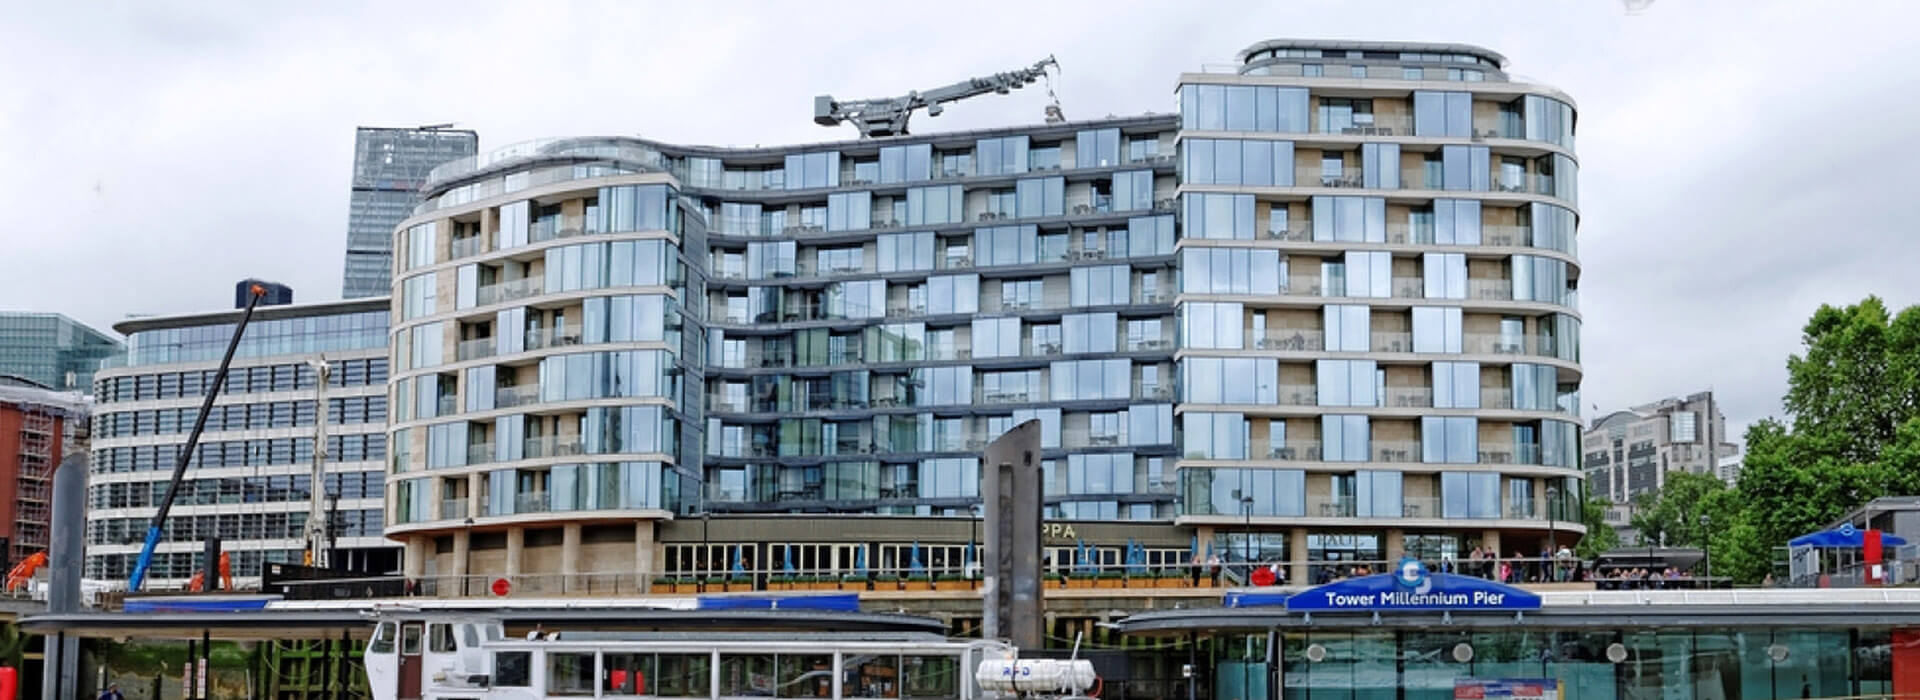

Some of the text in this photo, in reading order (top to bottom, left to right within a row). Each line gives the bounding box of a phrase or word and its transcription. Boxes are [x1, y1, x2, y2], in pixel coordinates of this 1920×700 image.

[1325, 591, 1505, 606] Tower Millennium Pier
